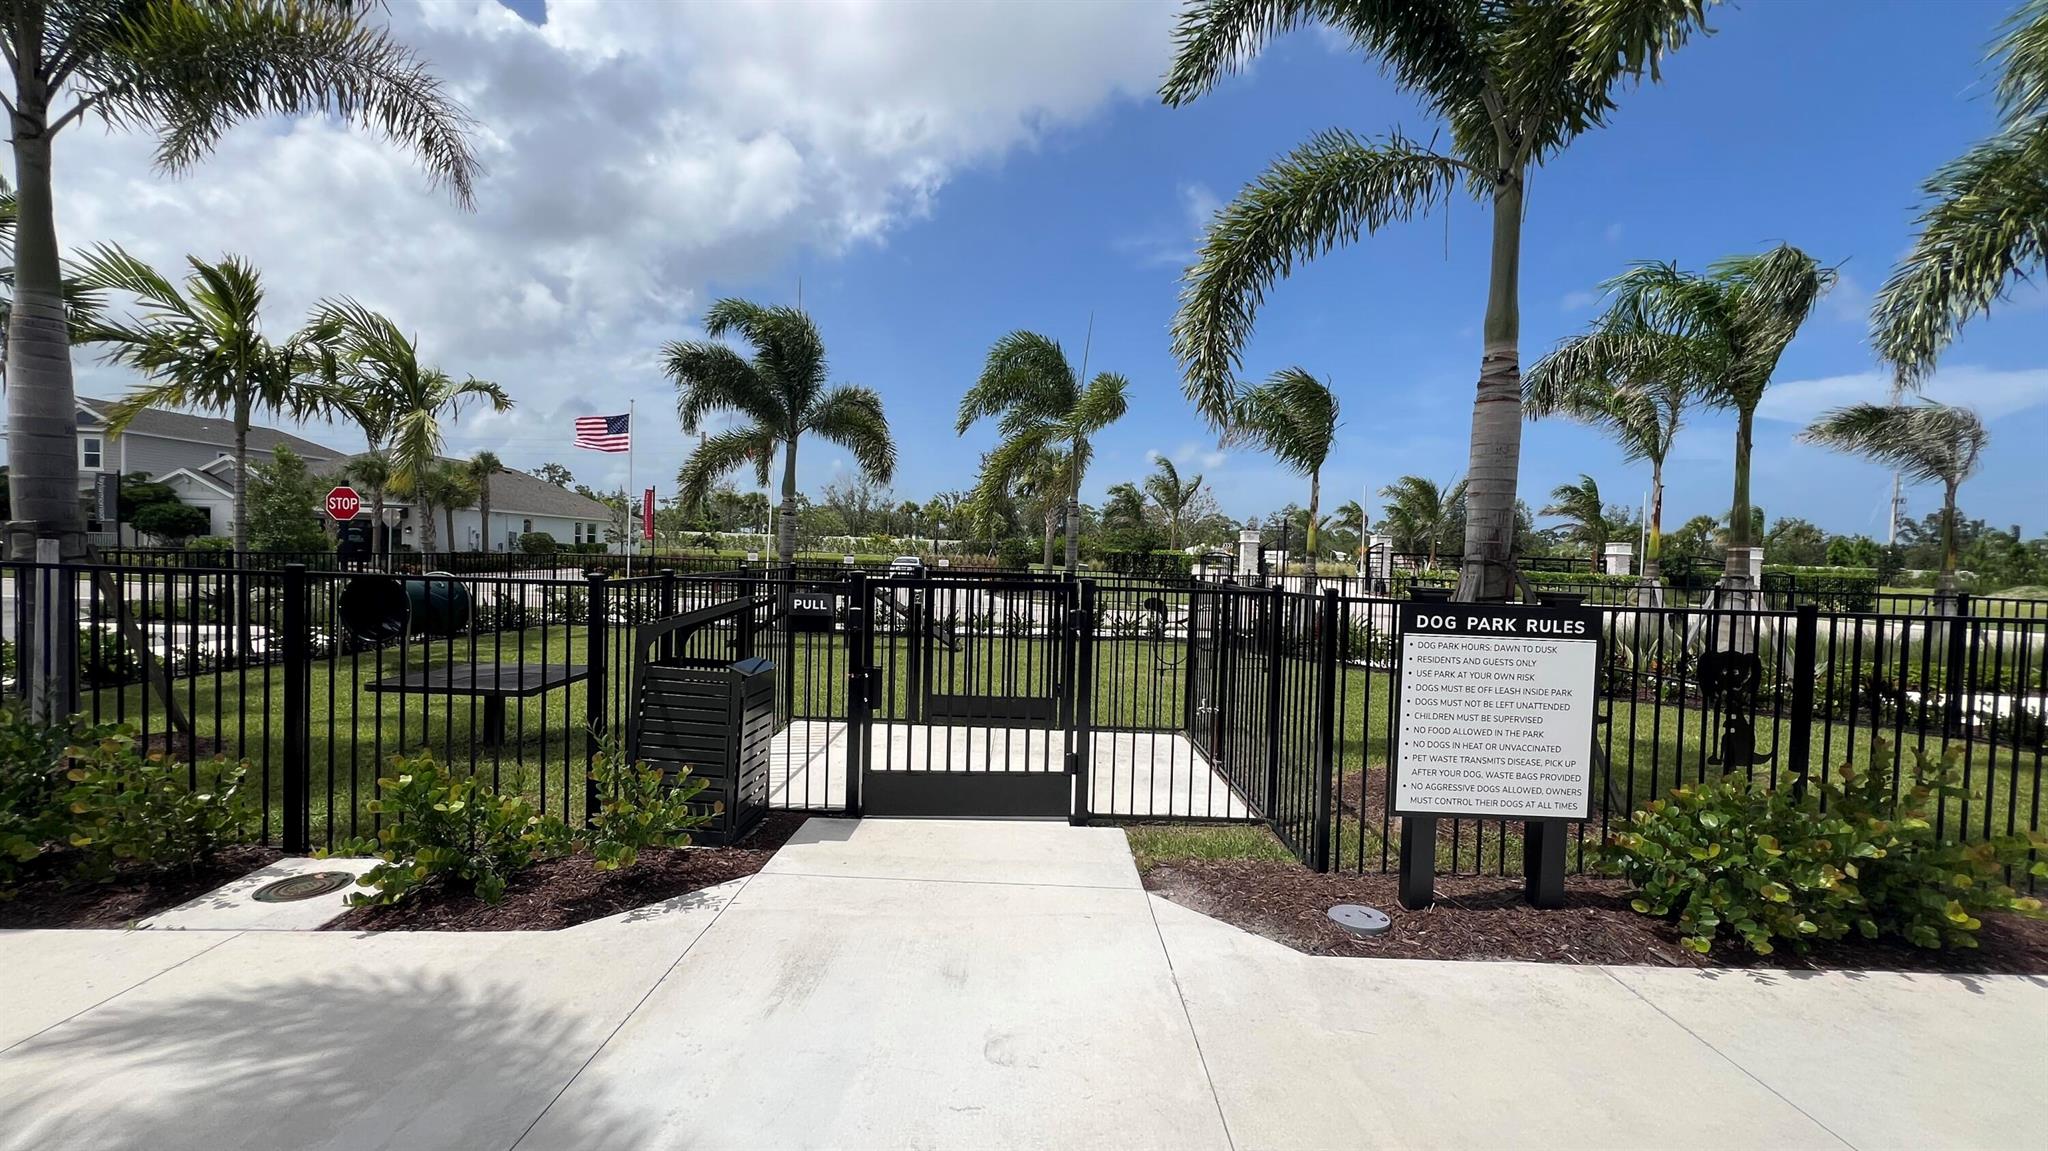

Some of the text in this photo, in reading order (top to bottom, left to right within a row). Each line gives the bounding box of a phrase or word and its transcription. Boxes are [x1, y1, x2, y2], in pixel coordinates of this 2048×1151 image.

[329, 497, 357, 510] STOP
[794, 599, 827, 610] PULL
[1416, 615, 1585, 634] DOG PARK RULES
[1417, 641, 1435, 649] DOG
[1461, 642, 1491, 651] HOURS:
[1493, 644, 1520, 652] DAWN
[1535, 645, 1557, 653] DUSK
[1417, 655, 1536, 667] RESIDENTS AND GUESTS ONLY
[1416, 669, 1432, 677] USE
[1434, 670, 1455, 678] PARK
[1469, 671, 1491, 679] YOUR
[1493, 672, 1514, 680] OWN
[1516, 673, 1534, 681] RISK
[1415, 683, 1438, 691] DOGS
[1440, 684, 1463, 692] MUST
[1465, 685, 1475, 693] BE
[1494, 686, 1520, 694] LEASH
[1522, 687, 1548, 695] INSIDE
[1415, 697, 1438, 705] DOGS
[1440, 698, 1462, 706] MUST
[1464, 699, 1481, 707] NOT
[1483, 700, 1493, 708] BE
[1516, 701, 1570, 711] UNATTENDED
[1414, 712, 1543, 724] CHILDREN MUST BE SUPERVISED
[1427, 726, 1450, 734] FOOD
[1452, 727, 1492, 736] ALLOWED
[1505, 729, 1520, 737] THE
[1427, 740, 1450, 748] DOGS
[1499, 743, 1561, 753] UNVACCINATED
[1429, 754, 1457, 763] WASTE
[1459, 756, 1505, 765] TRANSMITS
[1507, 757, 1542, 766] DISEASE,
[1544, 759, 1562, 767] PICK
[1411, 768, 1581, 782] AFTER YOUR DOG, WASTE BAGS PROVIDED
[1425, 782, 1474, 791] AGGRESSIVE
[1477, 784, 1500, 792] DOGS
[1502, 785, 1543, 794] ALLOWED,
[1545, 787, 1582, 796] OWNERS
[1410, 796, 1432, 804] MUST
[1434, 797, 1472, 805] CONTROL
[1475, 798, 1498, 806] THEIR
[1500, 799, 1523, 807] DOGS
[1537, 801, 1551, 809] ALL
[1554, 802, 1577, 810] TIMES
